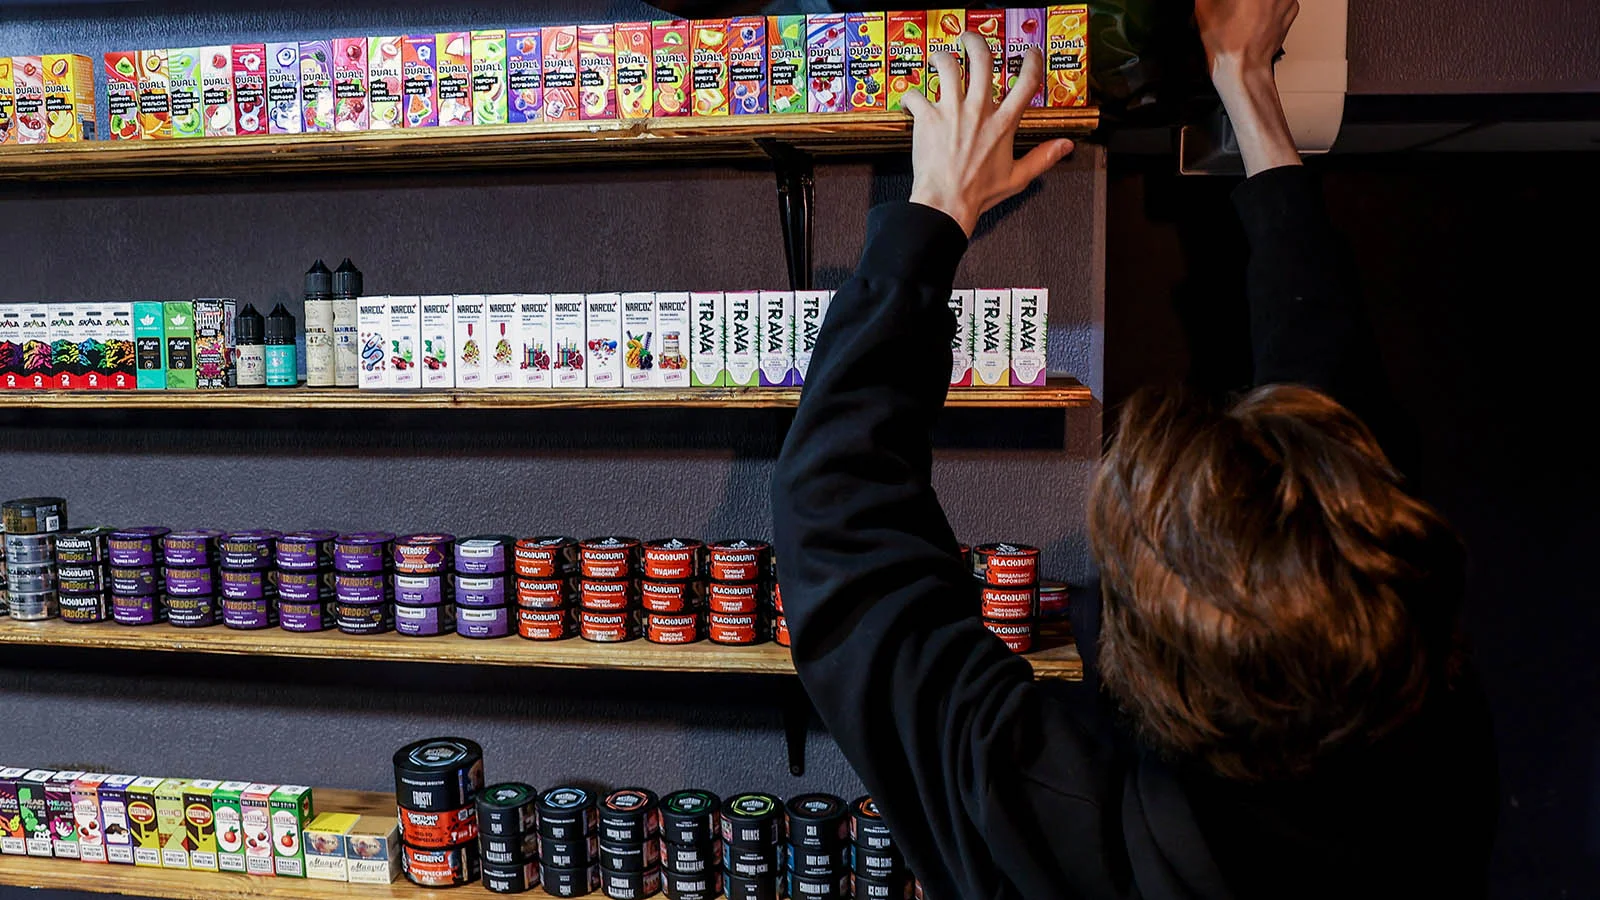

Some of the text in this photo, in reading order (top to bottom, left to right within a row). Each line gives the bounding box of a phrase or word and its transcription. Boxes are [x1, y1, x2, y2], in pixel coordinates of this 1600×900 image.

[929, 44, 961, 52] DUALL
[1051, 40, 1084, 49] DUALL
[731, 52, 762, 60] DUALL
[771, 50, 803, 58] DUALL
[810, 49, 841, 57] DUALL
[618, 56, 648, 64] DUALL
[656, 54, 686, 62] DUALL
[694, 54, 724, 62] DUALL
[699, 300, 714, 354] TRAVA
[734, 300, 748, 354] TRAVA
[768, 298, 783, 353] TRAVA
[984, 296, 1000, 352] TRAVA
[1020, 295, 1037, 351] TRAVA
[742, 829, 759, 840] QUINCE
